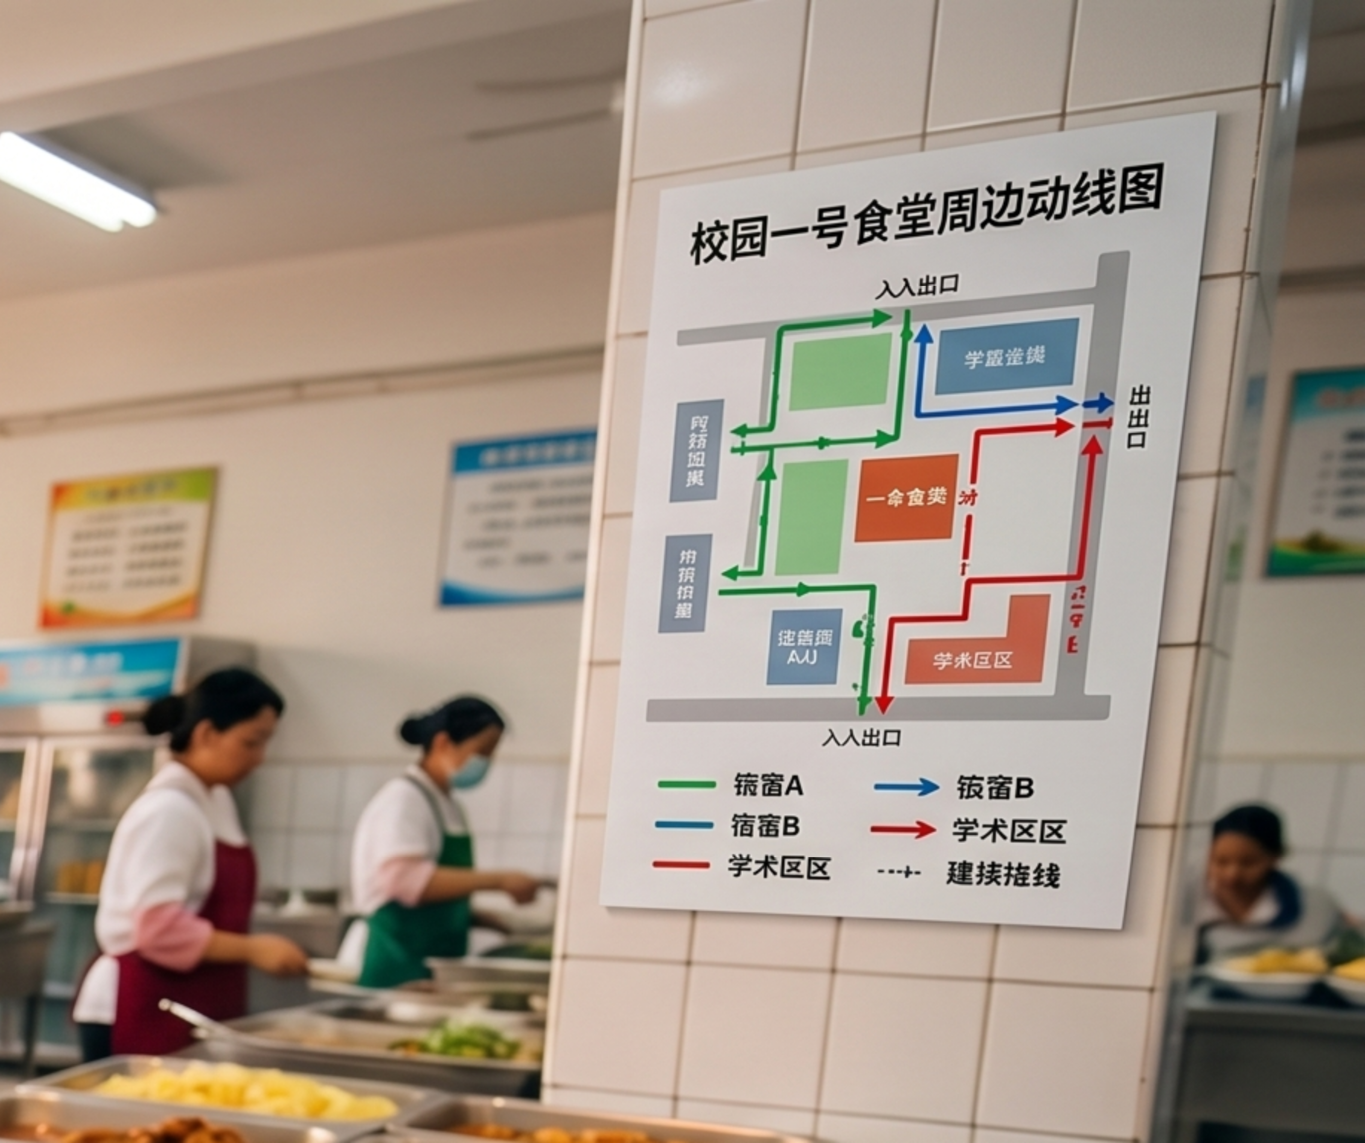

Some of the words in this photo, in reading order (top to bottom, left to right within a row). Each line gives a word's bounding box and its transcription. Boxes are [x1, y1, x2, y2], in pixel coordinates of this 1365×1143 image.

[690, 162, 1165, 266] 校园一号食堂周边动线图
